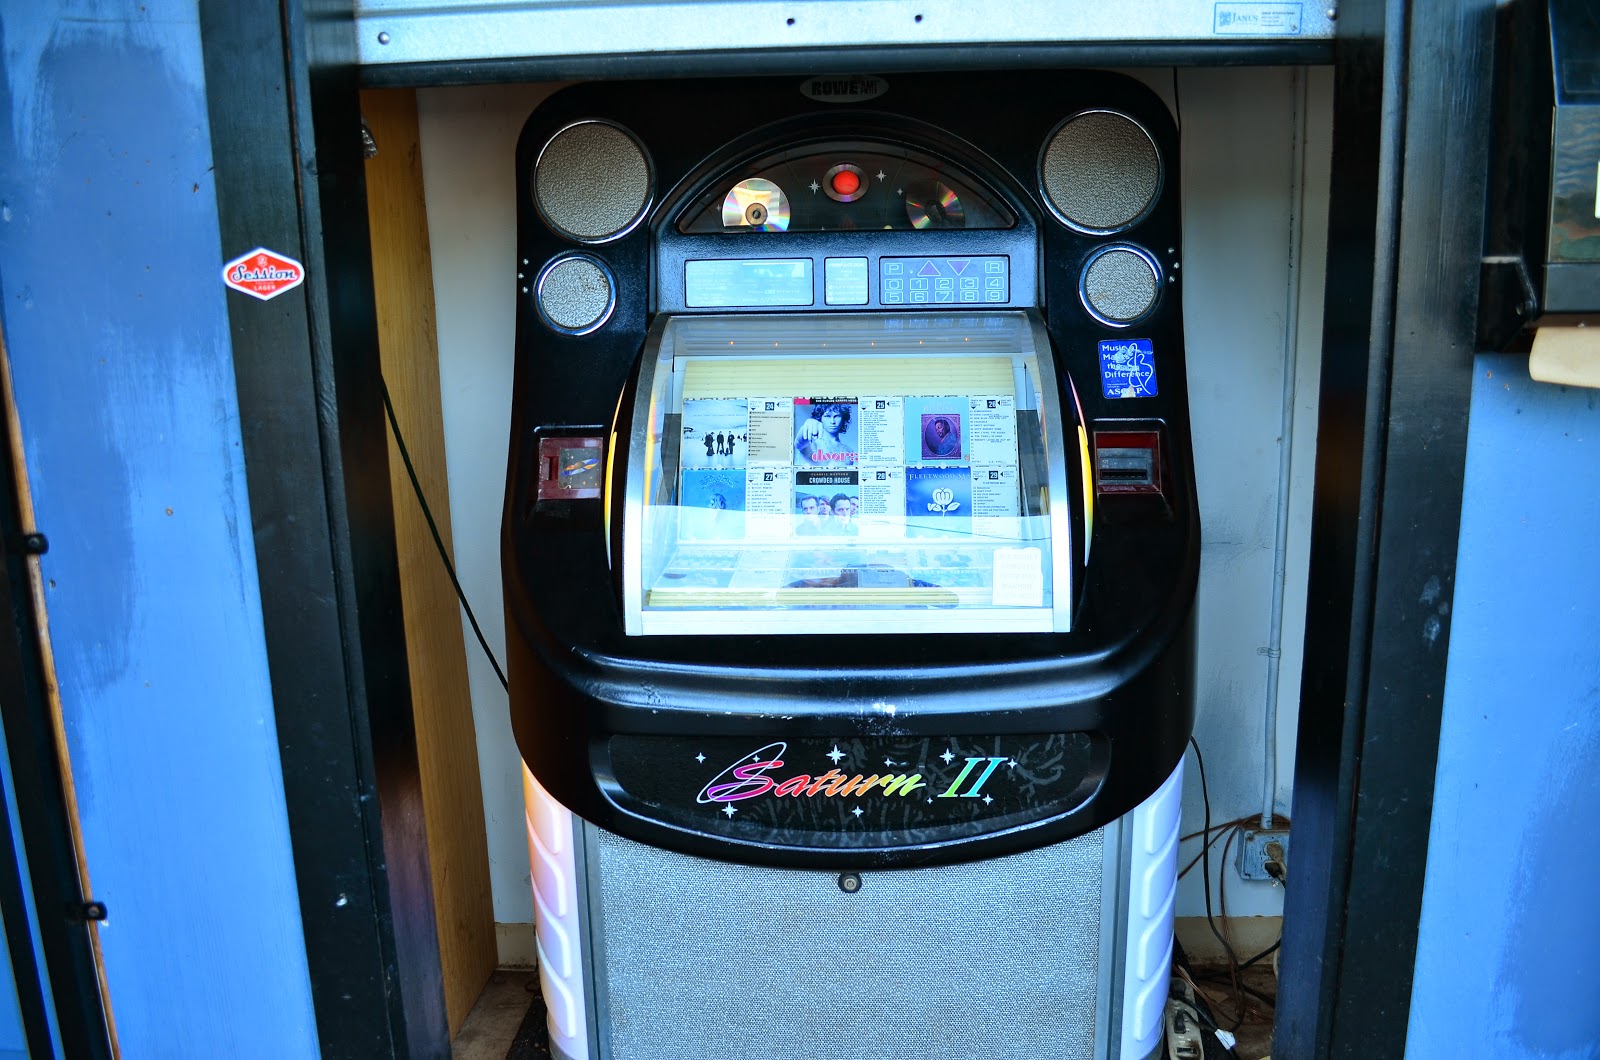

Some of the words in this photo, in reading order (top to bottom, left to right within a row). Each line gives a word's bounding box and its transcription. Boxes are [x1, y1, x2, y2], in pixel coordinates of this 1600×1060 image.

[1232, 13, 1258, 23] JANUS
[812, 80, 858, 95] ROWE
[232, 265, 296, 281] Session
[888, 264, 899, 273] P
[989, 262, 1000, 272] R
[939, 279, 950, 289] 2
[964, 279, 975, 288] 3
[989, 278, 1000, 288] 4
[889, 292, 899, 302] 5
[914, 292, 925, 301] 6
[939, 292, 950, 301] 7
[964, 291, 975, 301] 8
[989, 291, 1000, 301] 9
[834, 476, 851, 484] HOUSE
[706, 760, 926, 802] Saturn
[937, 757, 1008, 798] II
